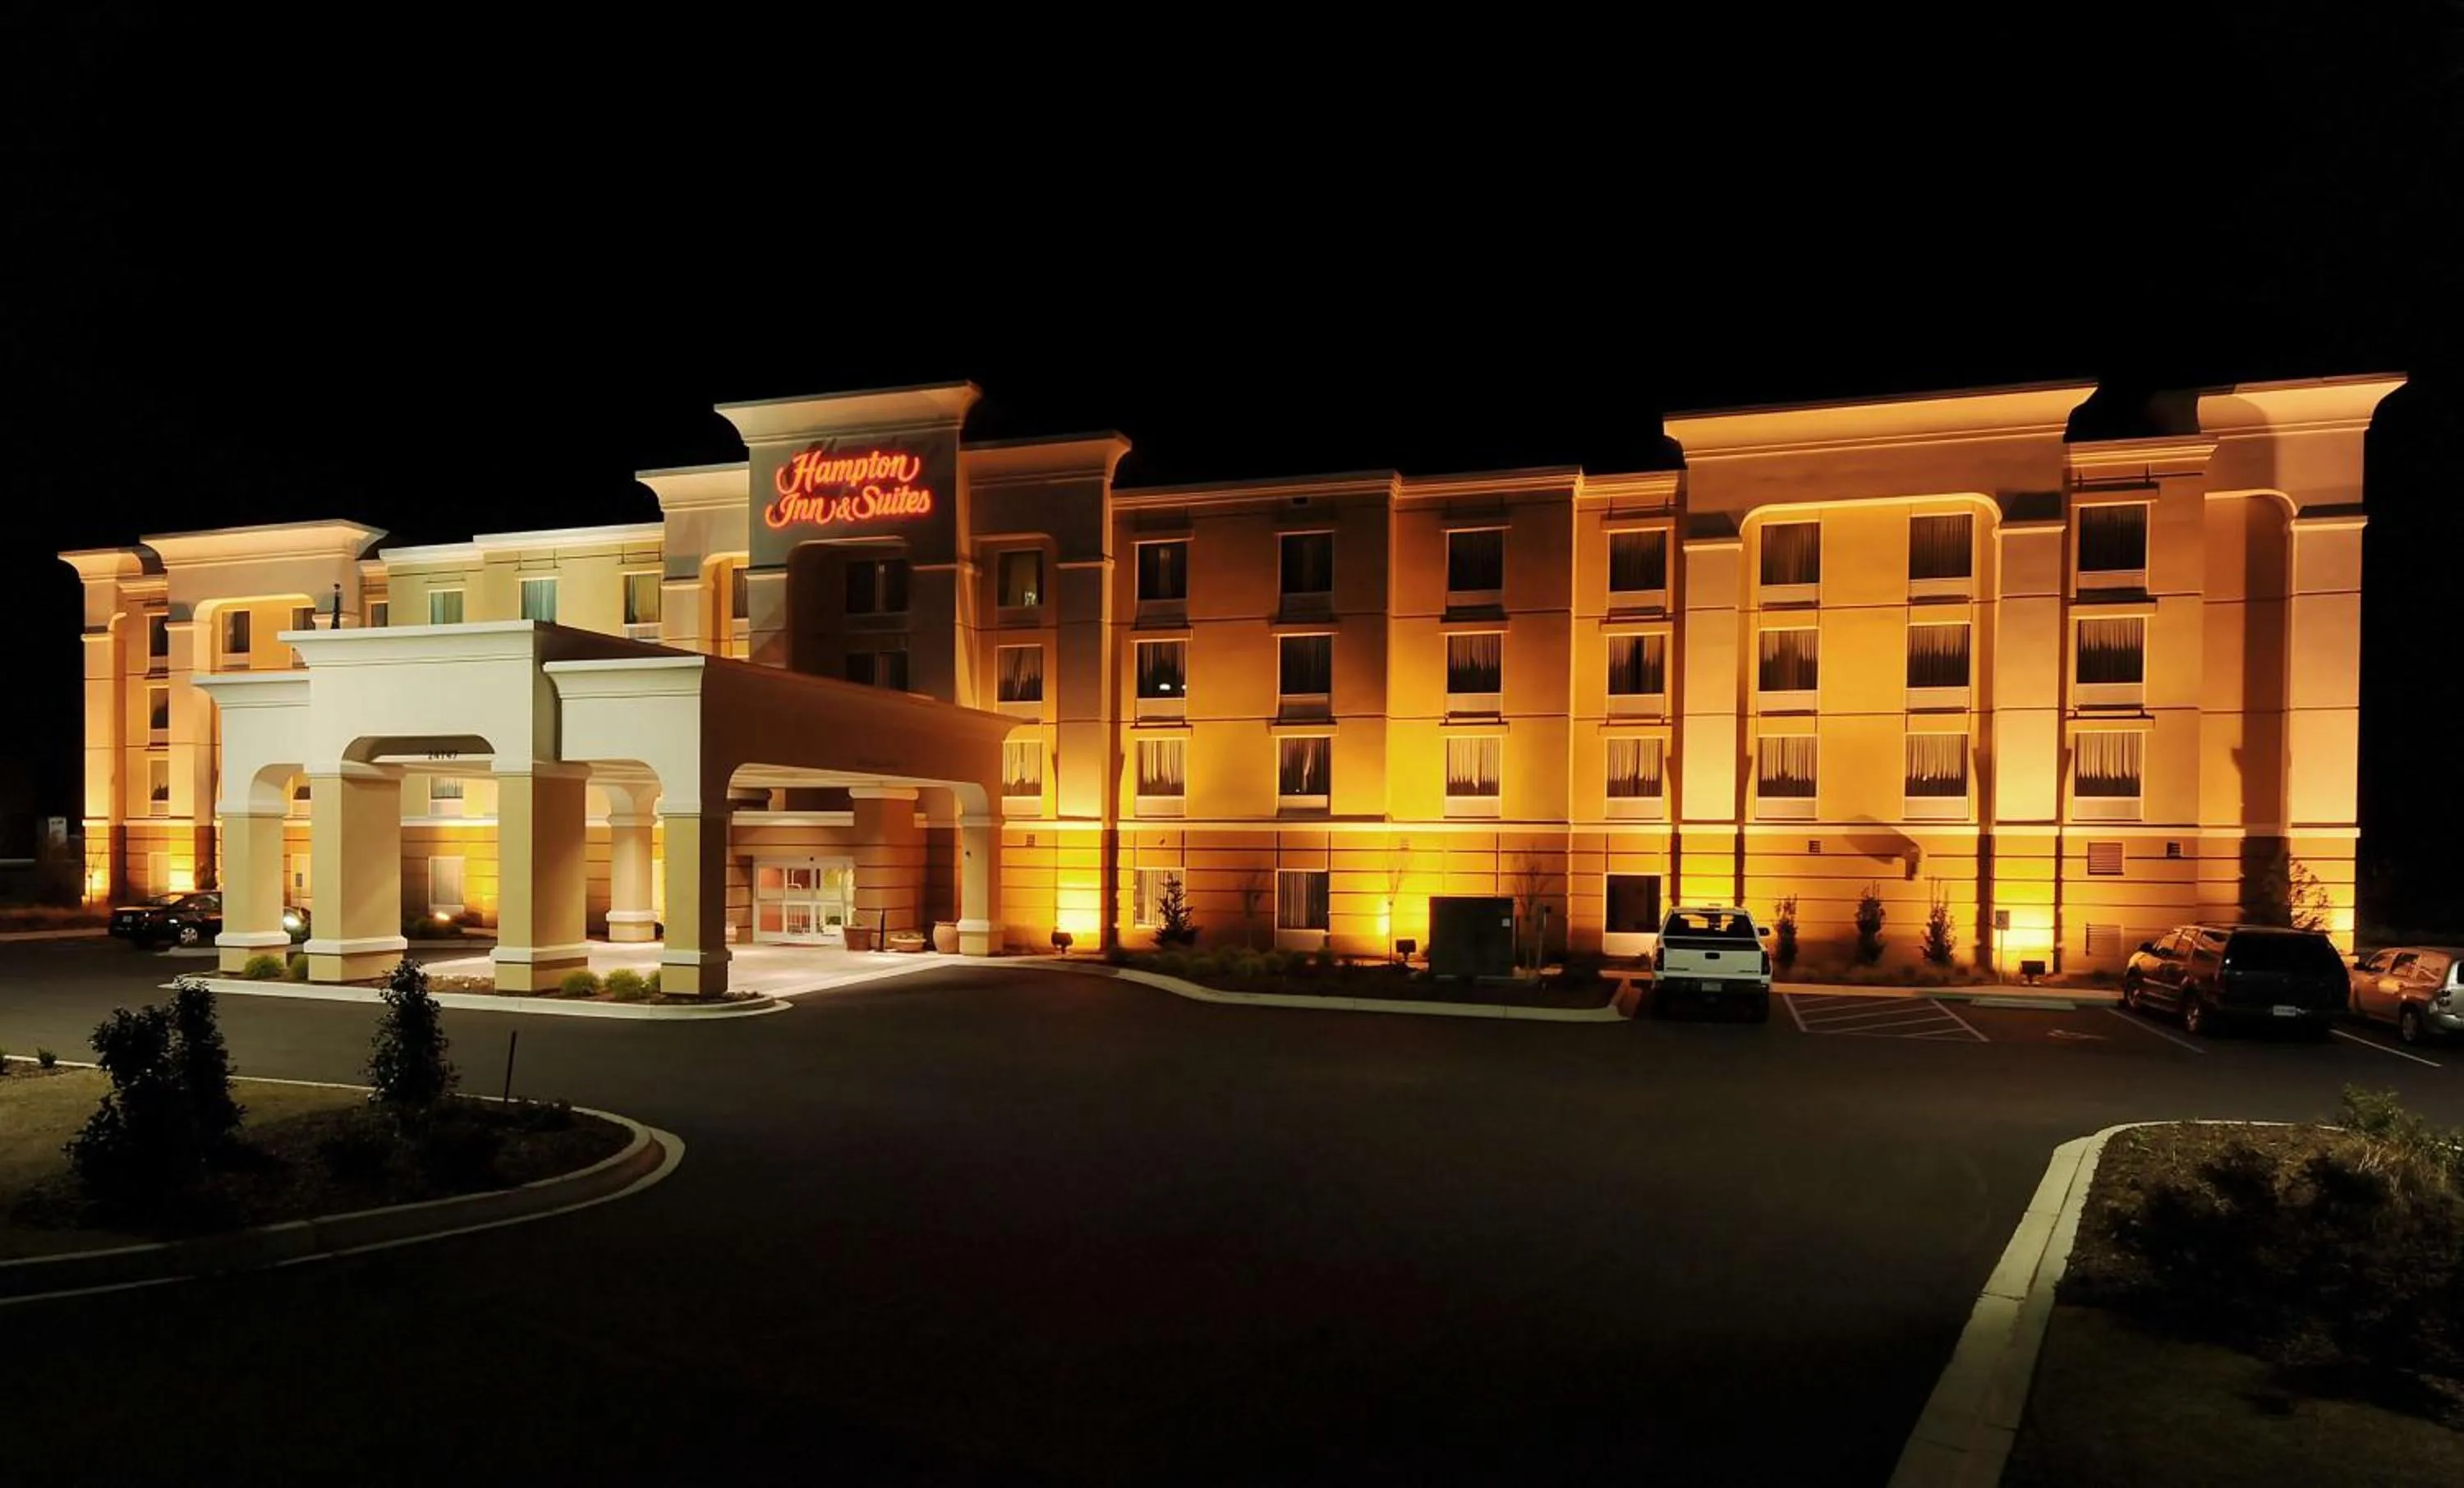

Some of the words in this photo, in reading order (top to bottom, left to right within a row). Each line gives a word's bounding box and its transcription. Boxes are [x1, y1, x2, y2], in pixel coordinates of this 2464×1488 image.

[775, 450, 920, 494] Hampton
[765, 492, 836, 527] Inn
[836, 496, 855, 521] &
[852, 485, 931, 519] Suites
